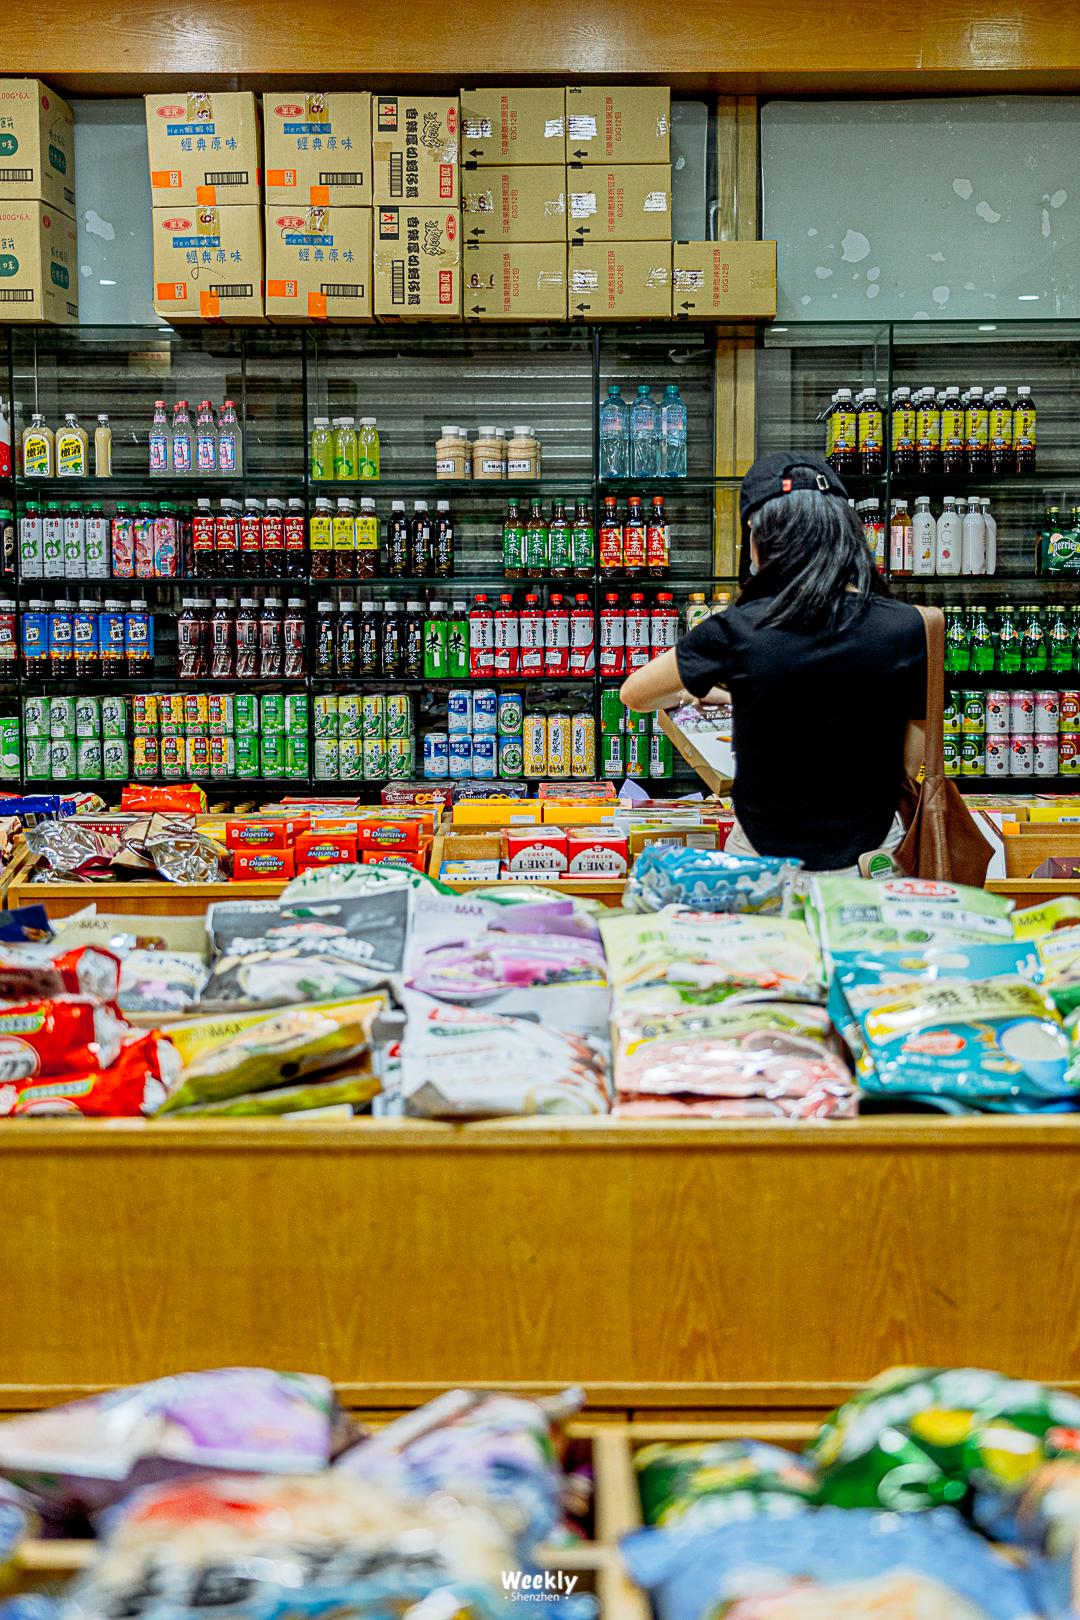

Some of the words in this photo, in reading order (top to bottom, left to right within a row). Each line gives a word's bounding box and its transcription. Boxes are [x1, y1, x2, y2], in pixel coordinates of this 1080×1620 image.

[2, 140, 14, 150] 味
[181, 137, 238, 151] 經典原味
[297, 137, 353, 150] 經典原味
[186, 250, 242, 263] 經典原味
[298, 249, 354, 263] 經典原味
[3, 261, 15, 270] 味
[508, 532, 518, 554] 生茶
[532, 532, 543, 554] 生茶
[555, 532, 566, 554] 生茶
[578, 532, 589, 554] 生茶
[606, 531, 618, 551] 生茶
[630, 531, 642, 551] 生茶
[652, 531, 661, 550] 生茶
[307, 850, 339, 858] Digestive
